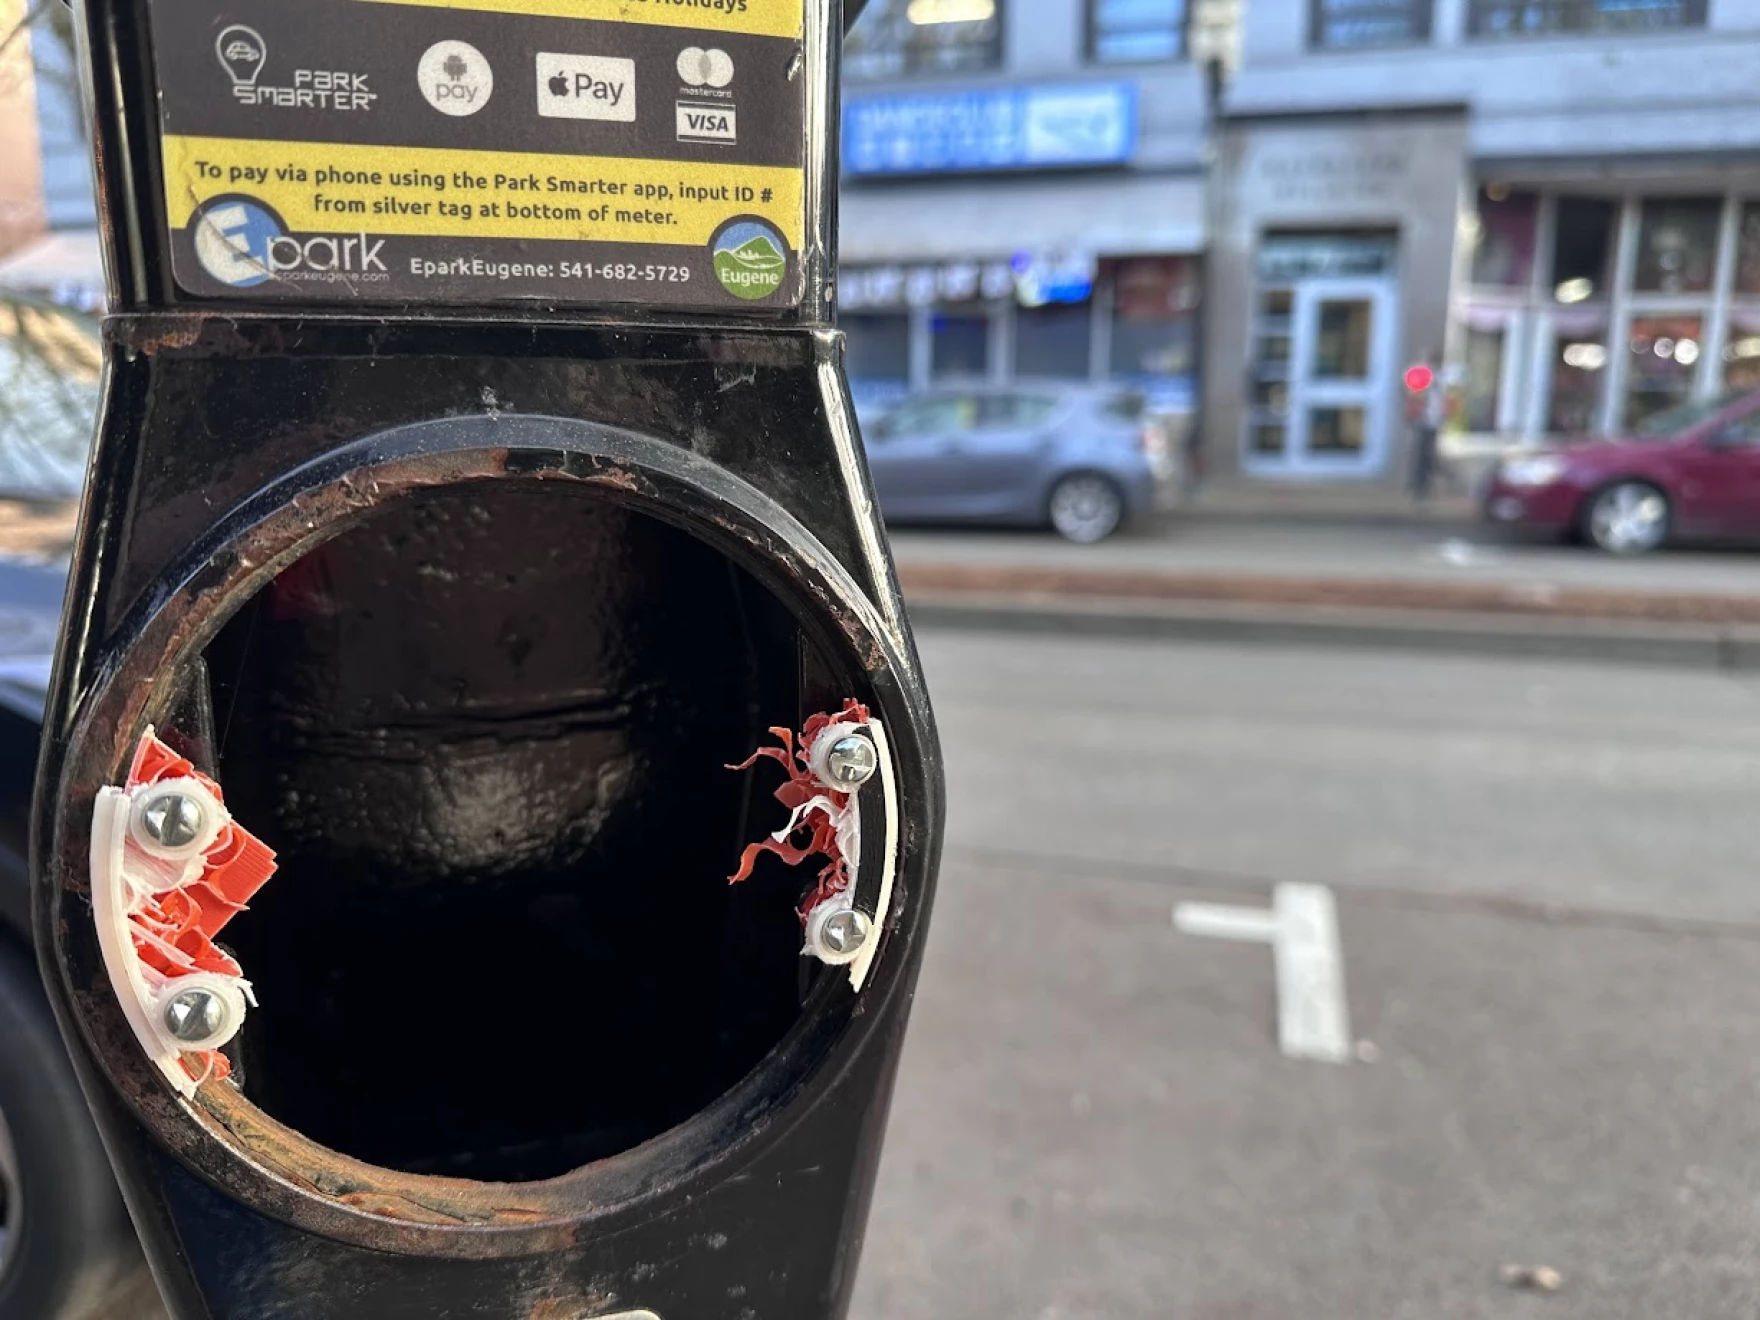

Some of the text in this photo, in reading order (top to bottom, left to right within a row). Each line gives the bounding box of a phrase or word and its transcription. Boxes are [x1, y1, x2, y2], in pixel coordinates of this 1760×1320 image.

[435, 82, 478, 103] pay
[575, 75, 624, 106] Pay
[685, 113, 729, 132] VISA
[196, 162, 774, 202] To pay via phone using the Park Smarter app, input ID #
[314, 194, 678, 226] from silver tag at bottom of meter.
[410, 257, 690, 283] EparkEugene: 541-682-5729
[720, 268, 779, 286] Eugene
